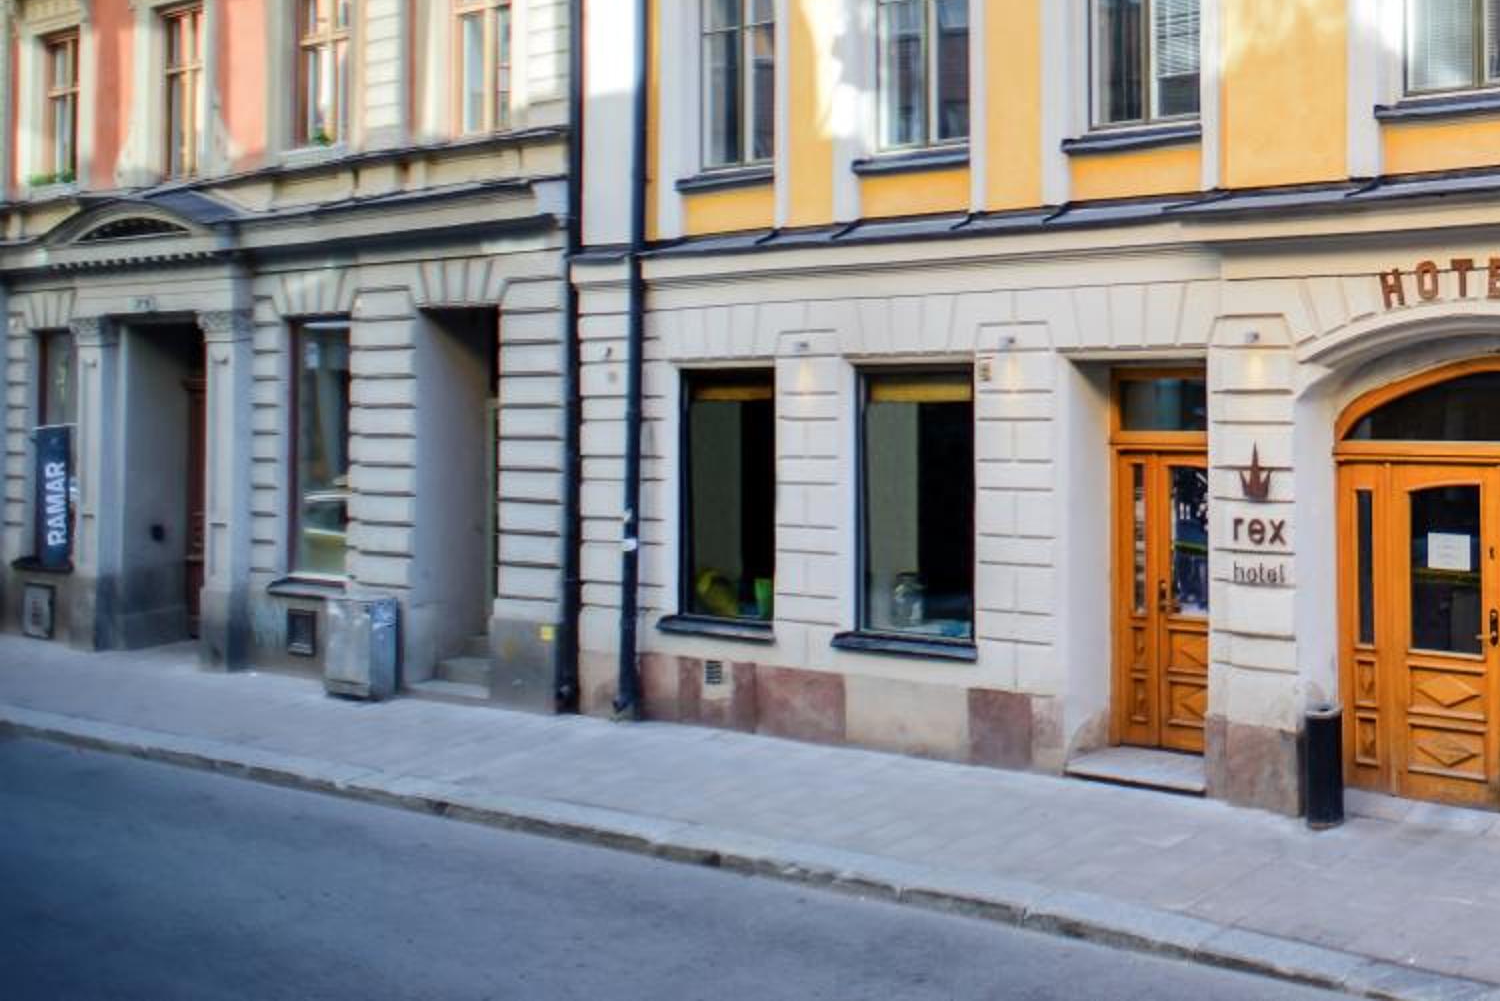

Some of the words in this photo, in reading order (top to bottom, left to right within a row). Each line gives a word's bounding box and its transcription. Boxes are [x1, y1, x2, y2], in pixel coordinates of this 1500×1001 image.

[45, 462, 67, 546] RAMAR
[1233, 517, 1287, 546] rex
[1233, 561, 1285, 584] hotel
